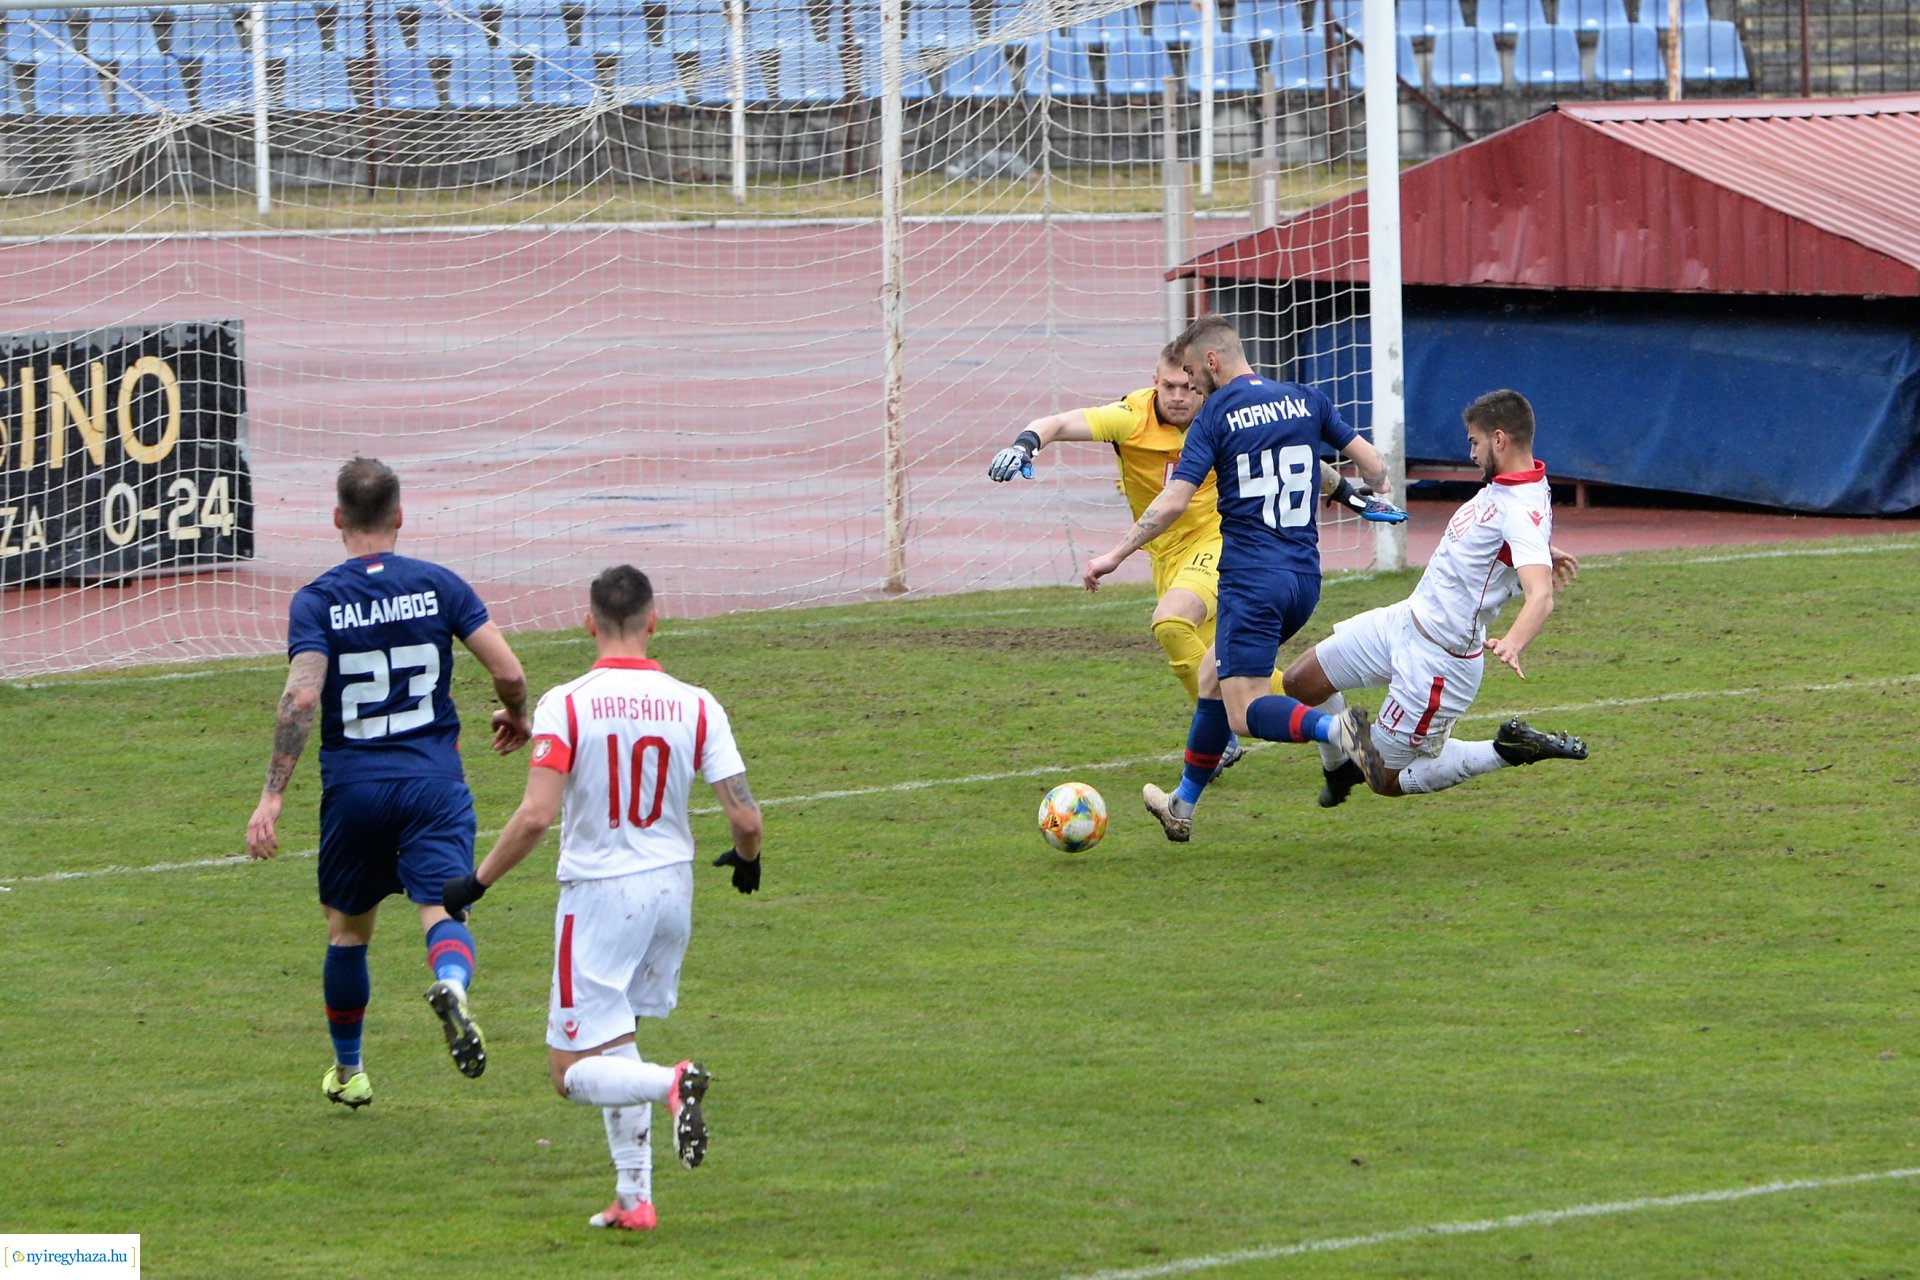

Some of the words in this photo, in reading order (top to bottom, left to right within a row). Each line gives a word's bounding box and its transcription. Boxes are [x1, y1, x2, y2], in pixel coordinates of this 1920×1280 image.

[0, 355, 181, 471] INO
[1226, 395, 1311, 432] HORNYÁK
[104, 476, 235, 546] 0-24
[1236, 444, 1314, 529] 48
[1192, 552, 1213, 569] 12
[329, 591, 439, 630] GALAMBOS
[338, 643, 441, 740] 23
[591, 694, 683, 722] HARSÁNYI
[1382, 699, 1405, 729] 14
[607, 733, 671, 829] 10
